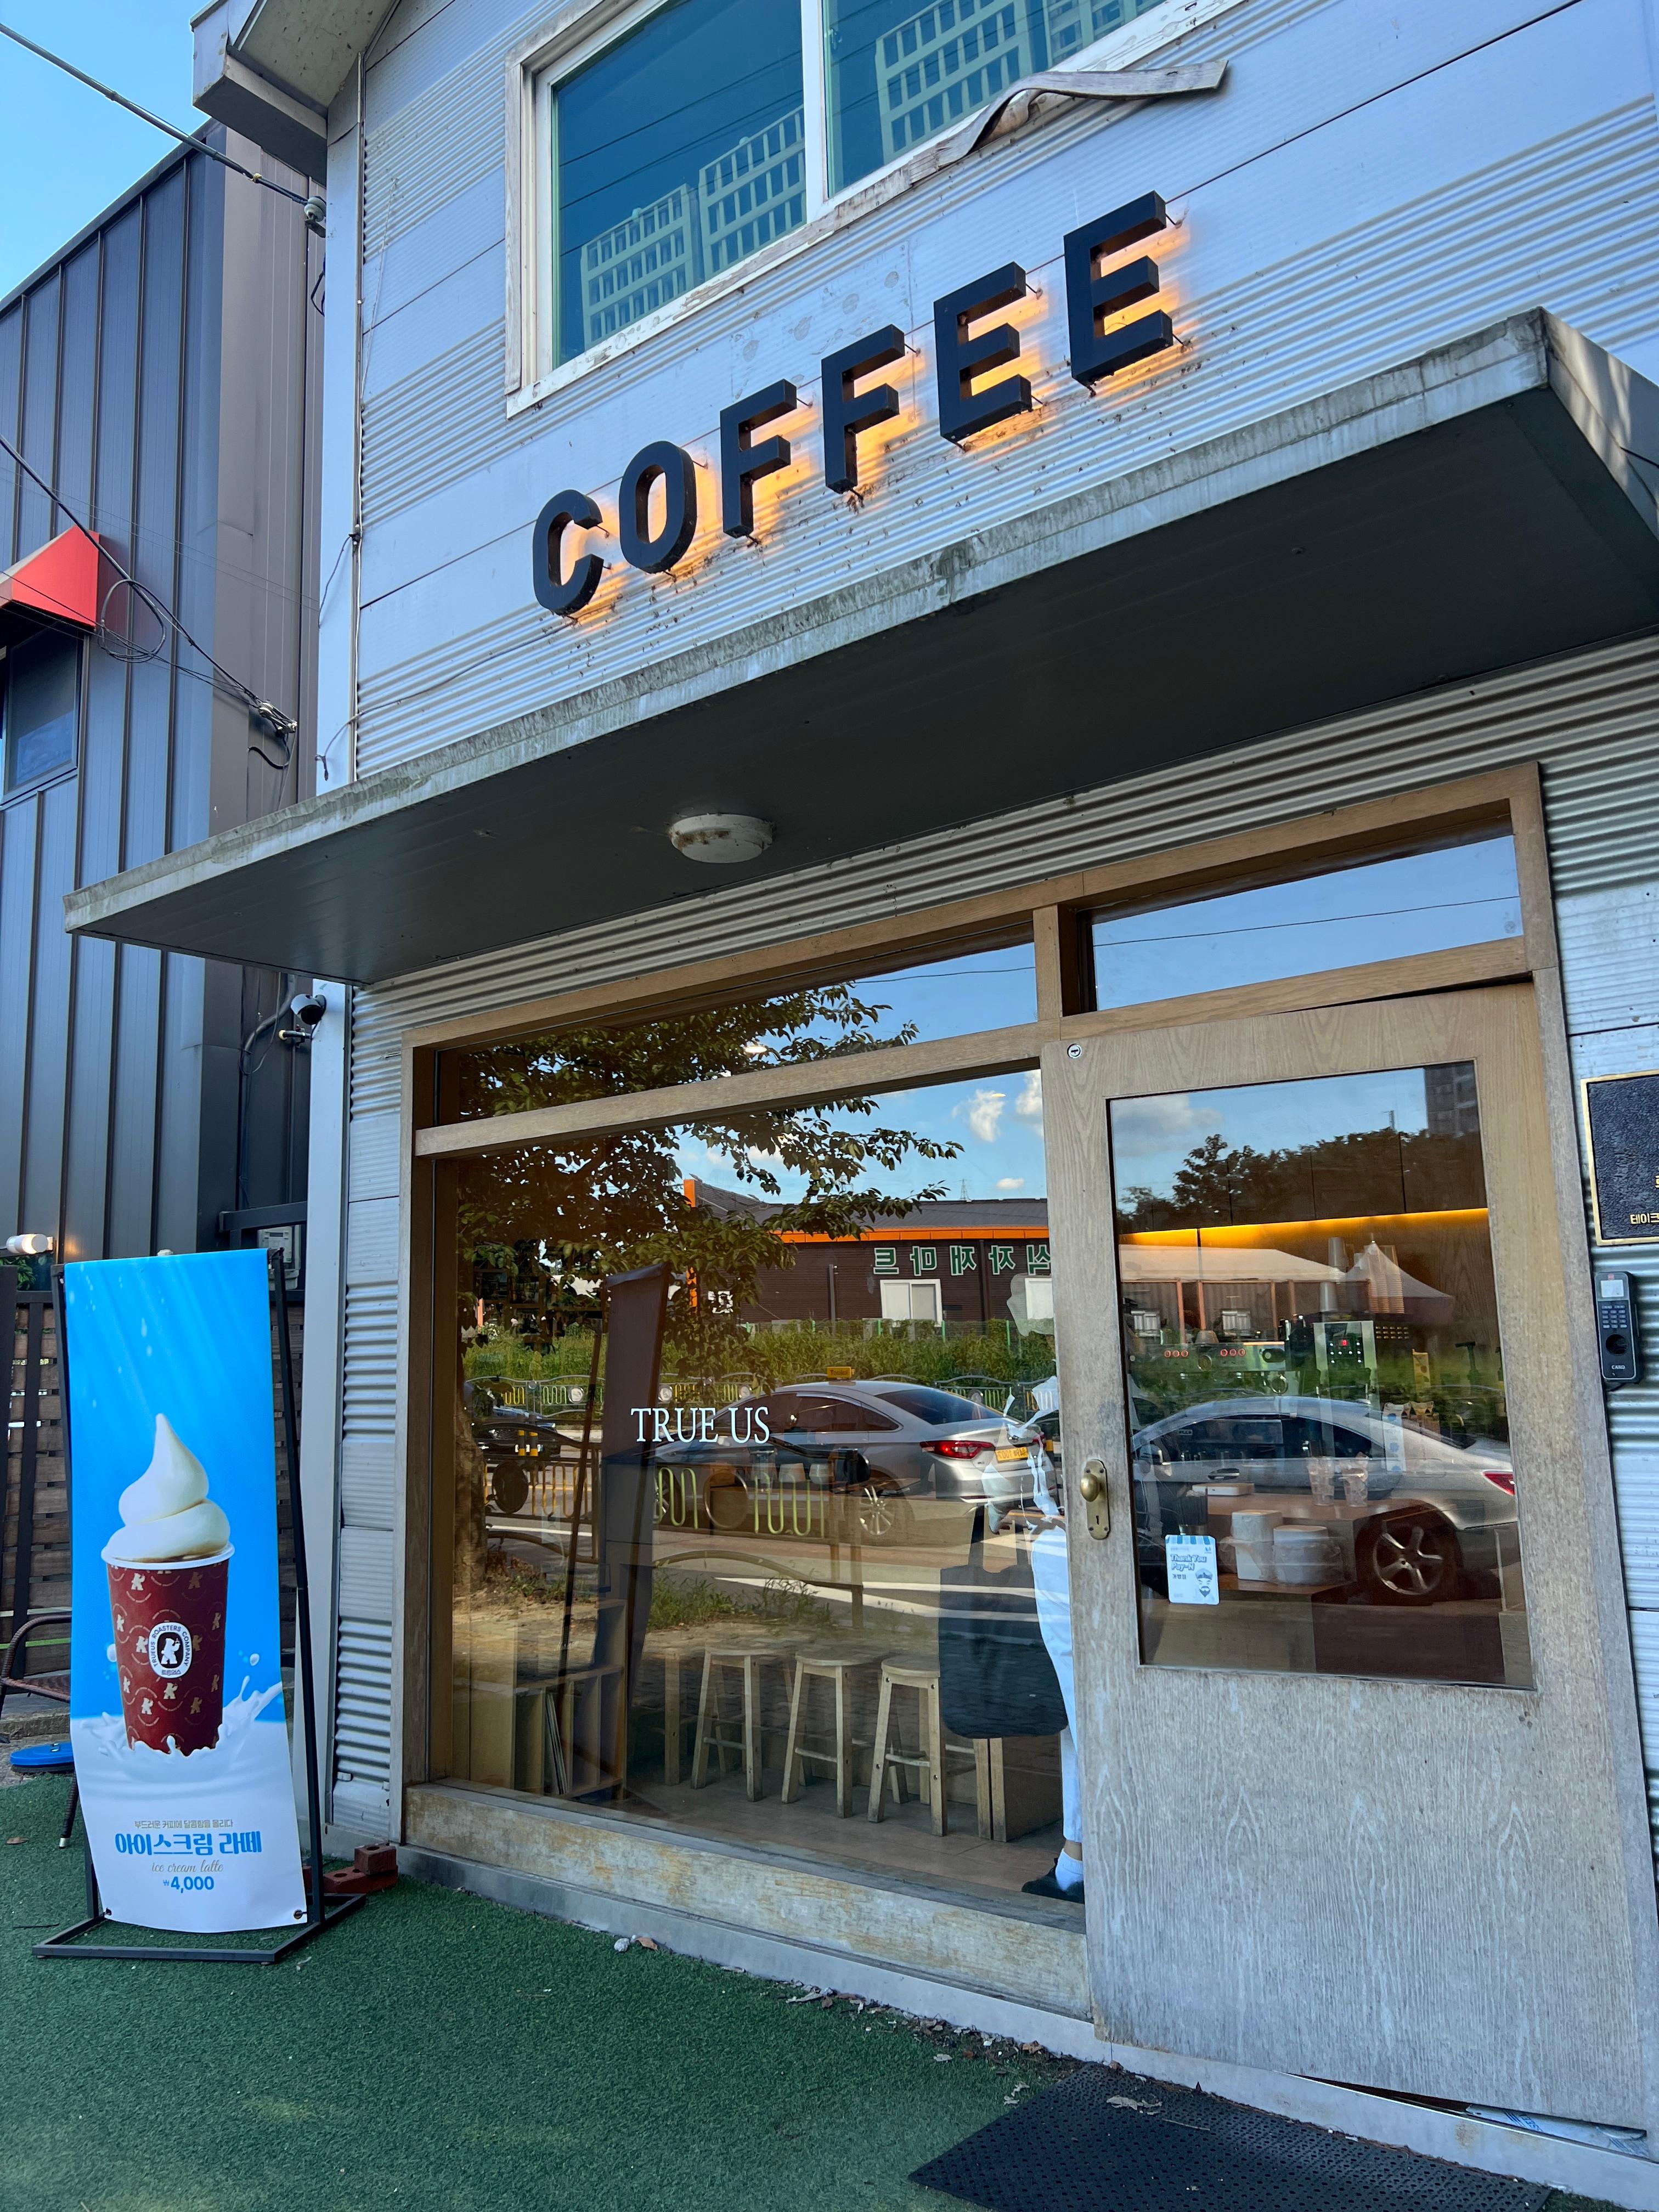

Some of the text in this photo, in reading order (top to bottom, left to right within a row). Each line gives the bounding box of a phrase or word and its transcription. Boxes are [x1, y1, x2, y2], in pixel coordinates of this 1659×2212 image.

[533, 190, 1173, 615] COFFEE
[630, 1406, 770, 1444] TRUE US
[150, 1625, 191, 1667] TRUEUS ROASTERS COMPANY
[134, 1820, 161, 1829] 부드러운
[162, 1820, 183, 1829] 커피에
[115, 1831, 262, 1856] 아이스크림 라떼
[151, 1859, 224, 1872] ice cream latte
